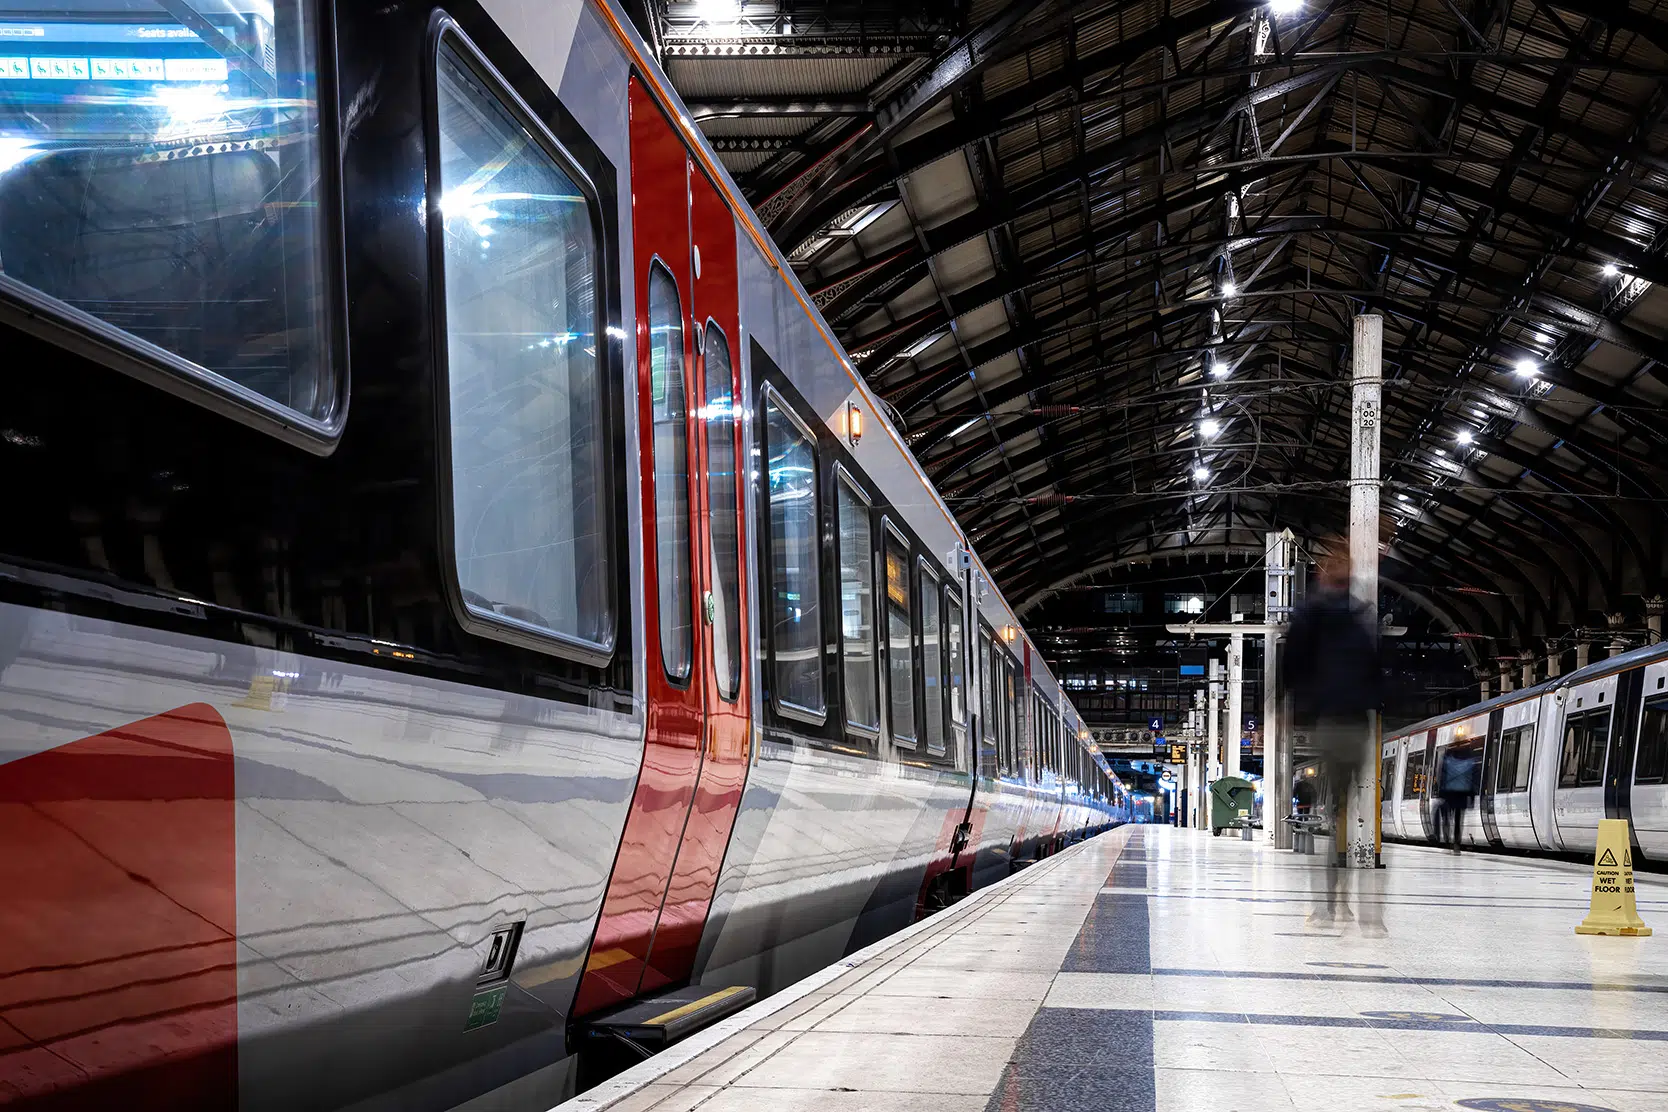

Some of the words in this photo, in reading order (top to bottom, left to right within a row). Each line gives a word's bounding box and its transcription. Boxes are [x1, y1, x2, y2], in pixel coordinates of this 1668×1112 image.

[138, 27, 166, 38] Seats
[1151, 719, 1160, 729] 4
[1247, 720, 1255, 730] 5
